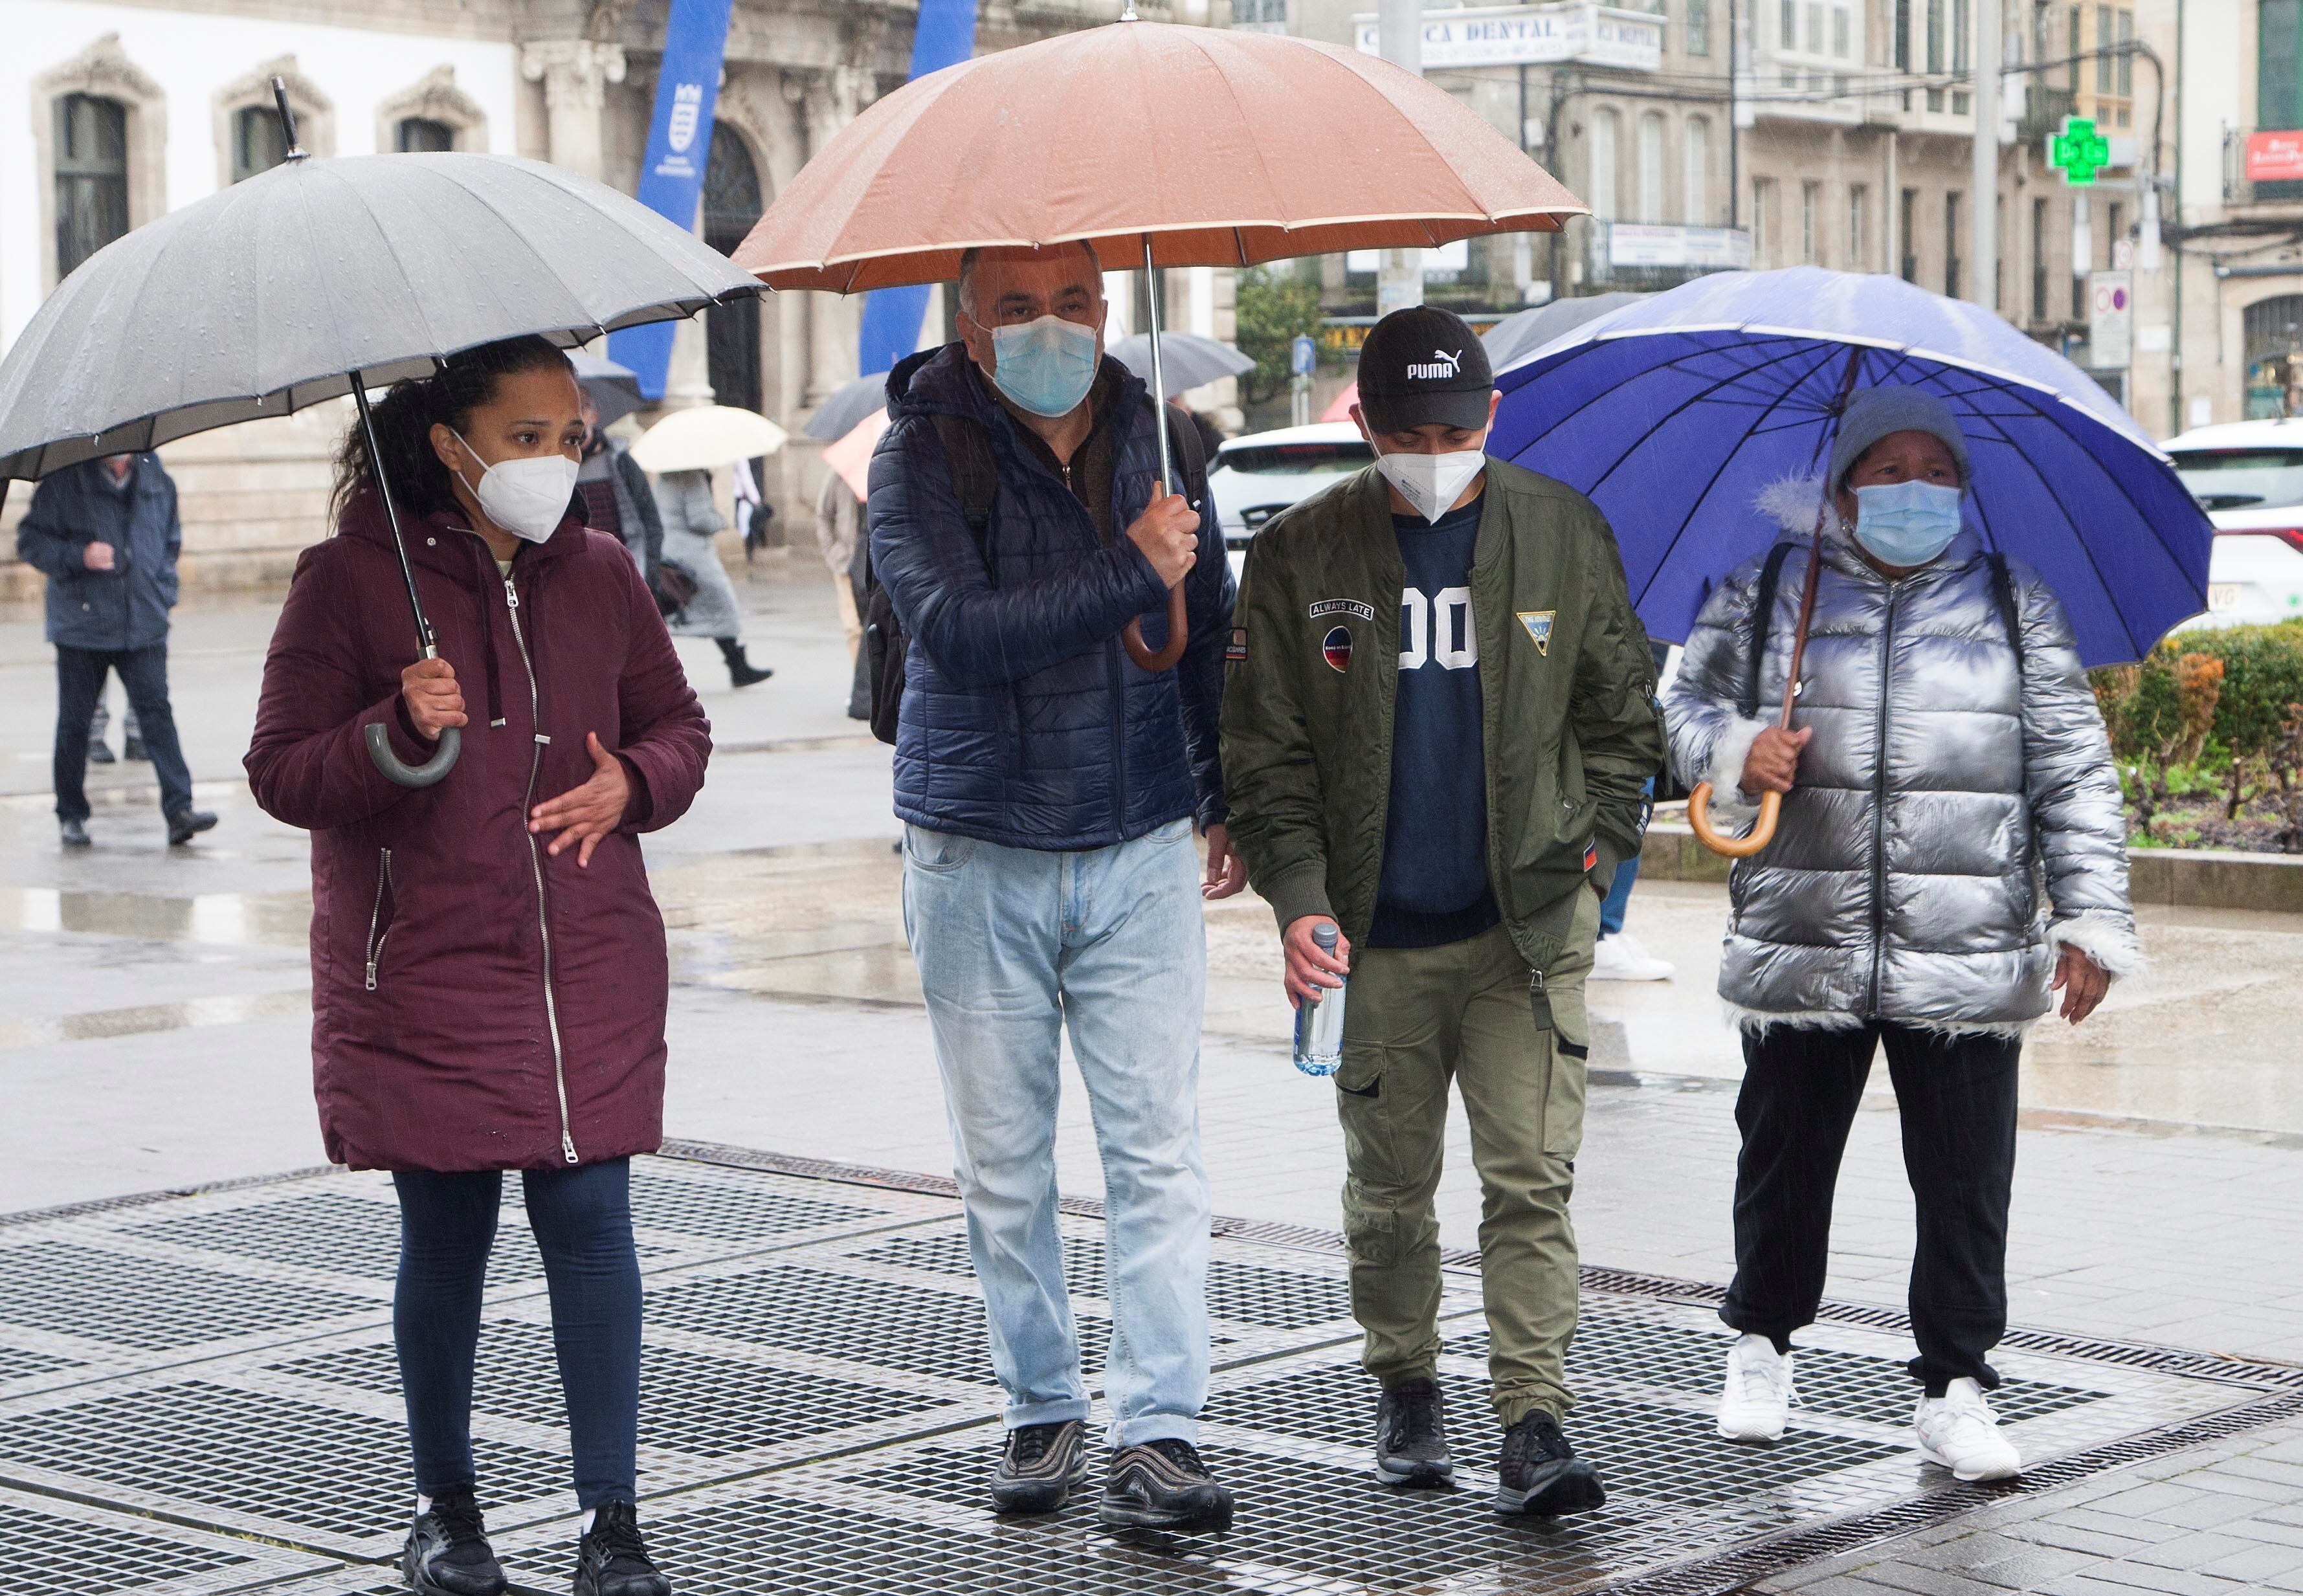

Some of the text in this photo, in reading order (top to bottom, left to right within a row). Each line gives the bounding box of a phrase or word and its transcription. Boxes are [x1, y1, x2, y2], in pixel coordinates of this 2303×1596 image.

[1466, 18, 1558, 41] DENTAL
[1407, 362, 1452, 379] PUMA
[1313, 602, 1370, 616] ALWAYS LATE
